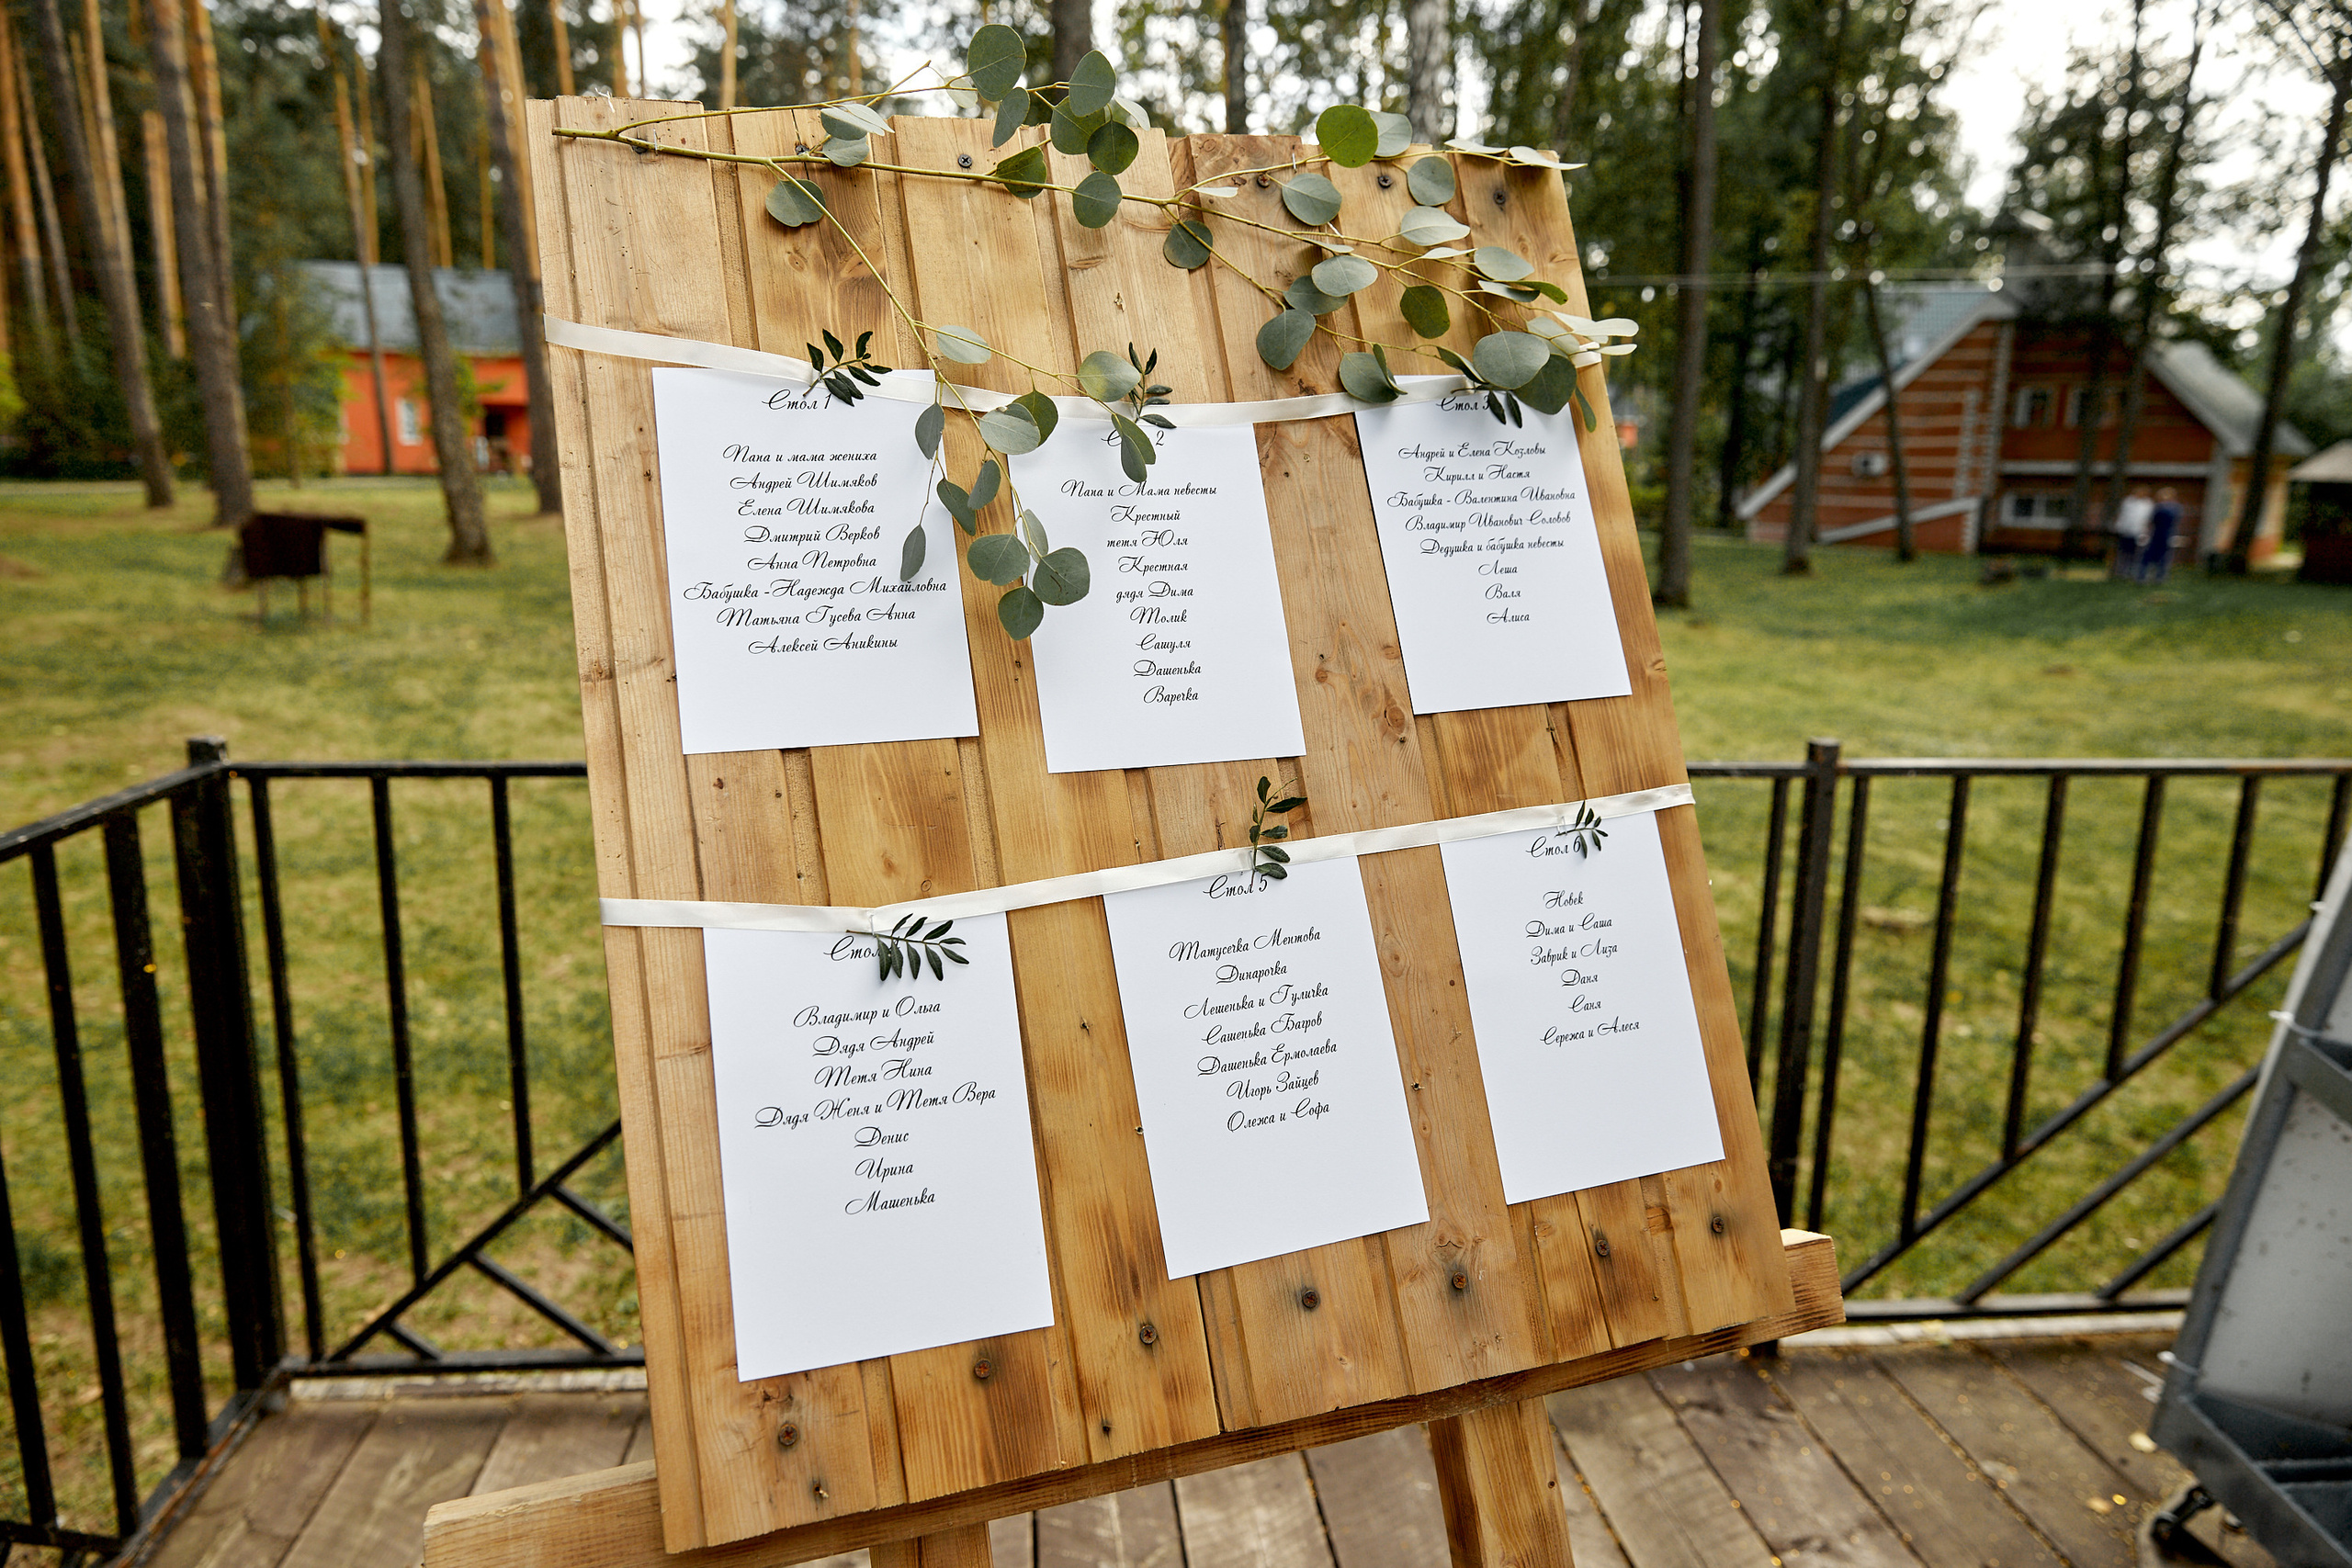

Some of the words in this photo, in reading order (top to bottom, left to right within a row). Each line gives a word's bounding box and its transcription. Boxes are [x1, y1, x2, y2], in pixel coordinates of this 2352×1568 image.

[762, 389, 818, 410] Стол
[1436, 396, 1479, 412] Стол
[1155, 430, 1165, 446] 2
[723, 445, 771, 463] Папа
[775, 454, 784, 463] и
[786, 453, 826, 463] мама
[830, 453, 877, 461] жениха
[1398, 444, 1445, 462] Андрей
[1448, 450, 1455, 458] и
[1458, 442, 1490, 457] Елена
[1493, 440, 1545, 458] Козловы
[729, 472, 792, 493] Андрей
[797, 471, 877, 488] Шимяков
[1424, 467, 1475, 485] Кирилл
[1477, 472, 1485, 480] и
[1487, 464, 1530, 479] Настя
[1061, 479, 1103, 497] Папа
[1107, 489, 1115, 497] и
[1118, 481, 1170, 497] Мама
[1174, 482, 1216, 495] невесты
[1387, 491, 1442, 510] Бабушка
[1454, 489, 1517, 504] Валентина
[1521, 486, 1575, 502] Ивановна
[738, 499, 782, 515] Елена
[786, 498, 875, 514] Шимякова
[1111, 505, 1181, 525] Крестный
[1406, 515, 1465, 534] Владимир
[1468, 513, 1522, 527] Иванович
[744, 525, 820, 546] Дмитрий
[825, 524, 880, 545] Верков
[1106, 539, 1138, 548] тетя
[1141, 529, 1188, 547] Юля
[1420, 538, 1473, 558] Дедушка
[1476, 544, 1484, 552] и
[1486, 537, 1524, 554] бабушка
[1528, 536, 1564, 548] невесты
[748, 552, 798, 570] Анна
[802, 550, 876, 571] Петровна
[1118, 556, 1188, 576] Крестная
[1478, 559, 1517, 575] Леша
[684, 581, 759, 604] Бабушка
[850, 576, 946, 594] Михайловна
[1116, 591, 1143, 604] дядя
[1148, 581, 1193, 597] Дима
[1486, 583, 1521, 600] Валя
[717, 607, 799, 626] Татьяна
[806, 605, 861, 627] Гусева
[866, 603, 916, 621] Анна
[1130, 606, 1187, 624] Толик
[1487, 607, 1530, 624] Алиса
[748, 635, 818, 654] Алексей
[823, 632, 898, 650] Аникины
[1136, 633, 1191, 653] Сашуля
[1134, 660, 1202, 677] Дашенька
[1144, 685, 1199, 706] Варечка
[1525, 836, 1569, 858] Стол
[1573, 835, 1581, 852] 6
[1203, 874, 1254, 899] Стол
[1259, 874, 1269, 892] 5
[1525, 920, 1565, 938] Дима
[1568, 924, 1575, 933] и
[1577, 912, 1611, 931] Саша
[1253, 927, 1321, 949] Ментова
[1571, 950, 1577, 959] и
[1580, 938, 1617, 958] Лиза
[1216, 961, 1287, 985] Динарочка
[1561, 969, 1598, 987] Даня
[793, 1006, 877, 1029] Владимир
[881, 1008, 890, 1019] и
[896, 996, 941, 1018] Ольга
[1184, 995, 1255, 1019] Лешенька
[1258, 998, 1266, 1008] и
[1568, 995, 1601, 1012] Саня
[1202, 1022, 1266, 1045] Сашенька
[1271, 1010, 1322, 1033] Багров
[1540, 1026, 1585, 1047] Сережа
[1588, 1029, 1595, 1038] и
[1598, 1016, 1639, 1035] Алеся
[812, 1036, 865, 1058] Дядя
[870, 1028, 934, 1052] Андрей
[1197, 1052, 1267, 1077] Дашенька
[1271, 1038, 1337, 1066] Ермолаева
[814, 1066, 877, 1088] Тетя
[881, 1058, 933, 1080] Нина
[1227, 1079, 1272, 1100] Игорь
[1276, 1070, 1318, 1092] Зайцев
[754, 1107, 808, 1130] Дядя
[814, 1098, 870, 1121] Женя
[874, 1103, 883, 1114] и
[887, 1089, 948, 1111] Тетя
[953, 1081, 996, 1105] Вера
[1227, 1111, 1275, 1133] Олежа
[1279, 1111, 1287, 1122] и
[1290, 1098, 1329, 1120] Софа
[854, 1126, 909, 1148] Денис
[855, 1157, 913, 1183] Ирина
[845, 1188, 935, 1214] Машенька
